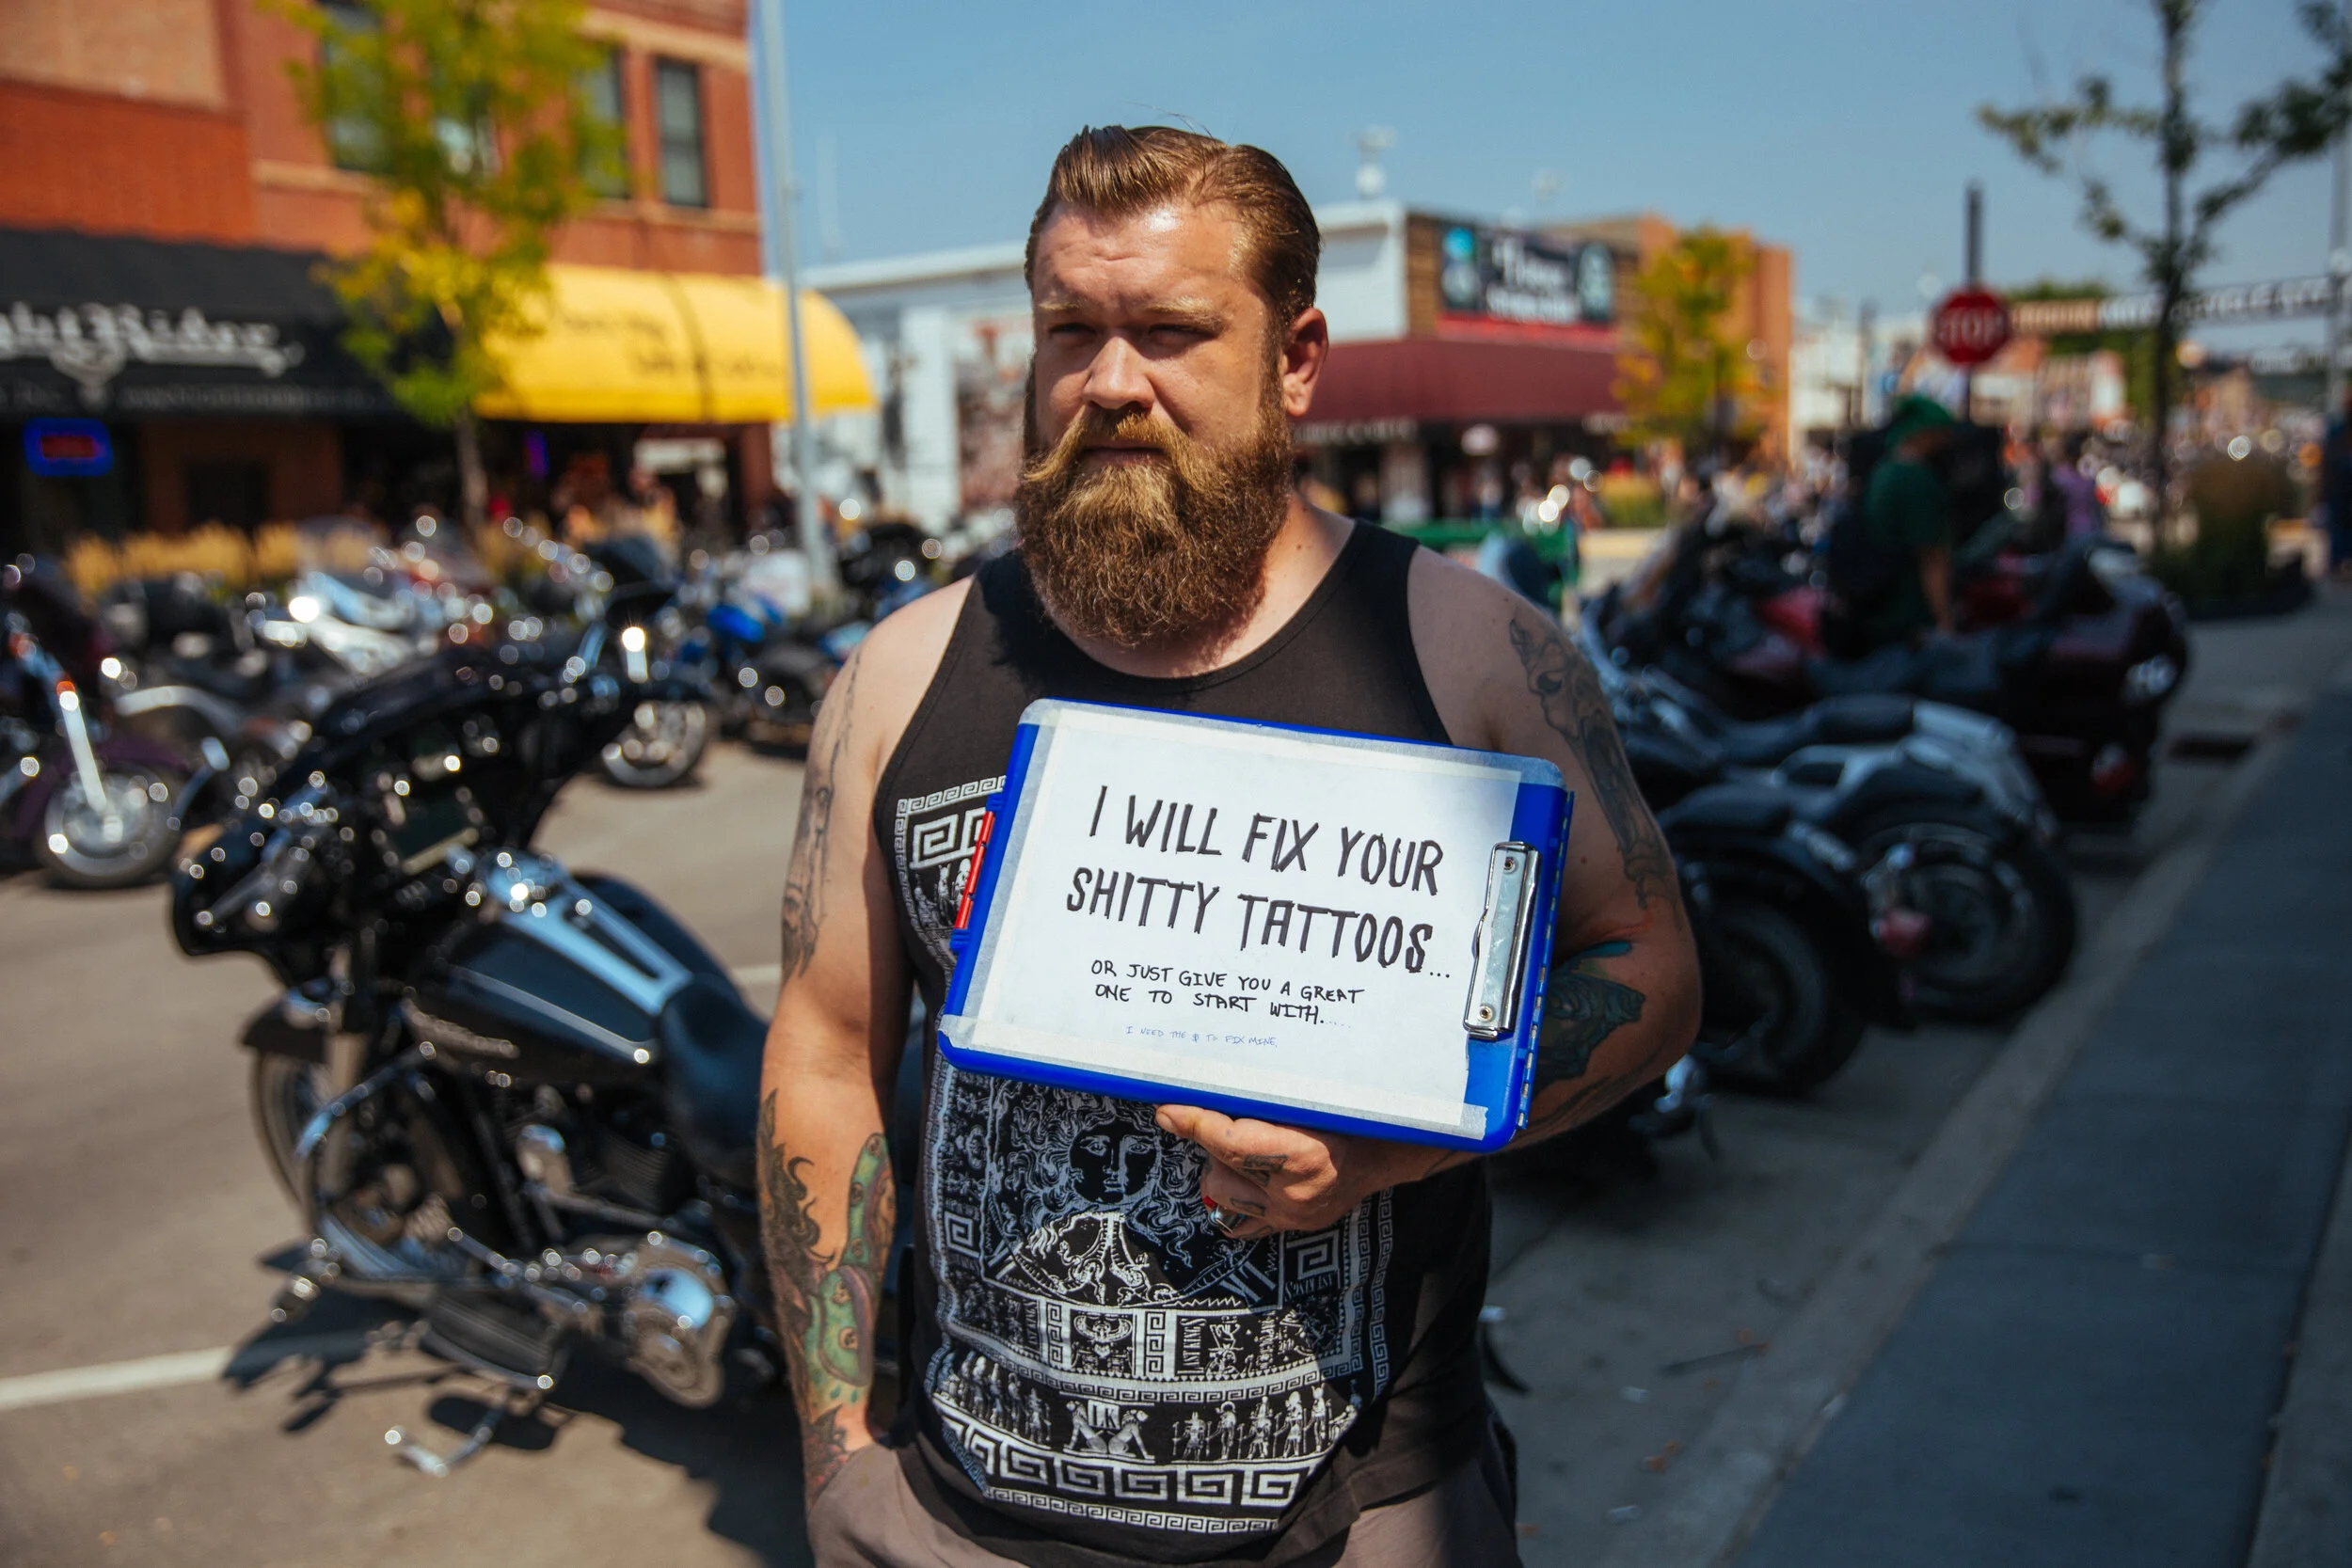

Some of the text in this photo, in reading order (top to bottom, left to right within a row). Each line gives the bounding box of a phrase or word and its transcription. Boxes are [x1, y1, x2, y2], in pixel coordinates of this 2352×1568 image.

[1938, 308, 2003, 348] STOP
[1089, 784, 1444, 896] I WILL FIX YOUR
[1066, 866, 1220, 935] SHITTY
[1090, 959, 1365, 1005] OR JUST GIVE YOU A GREAT
[1095, 984, 1132, 1003] ONE
[1148, 990, 1173, 1005] TO
[1192, 992, 1258, 1013] START
[1126, 1025, 1134, 1035] I
[1139, 1027, 1165, 1037] NEED
[1170, 1031, 1186, 1039] THE
[1224, 1035, 1246, 1045] FIX
[1177, 1318, 1208, 1375] LAST KINGS
